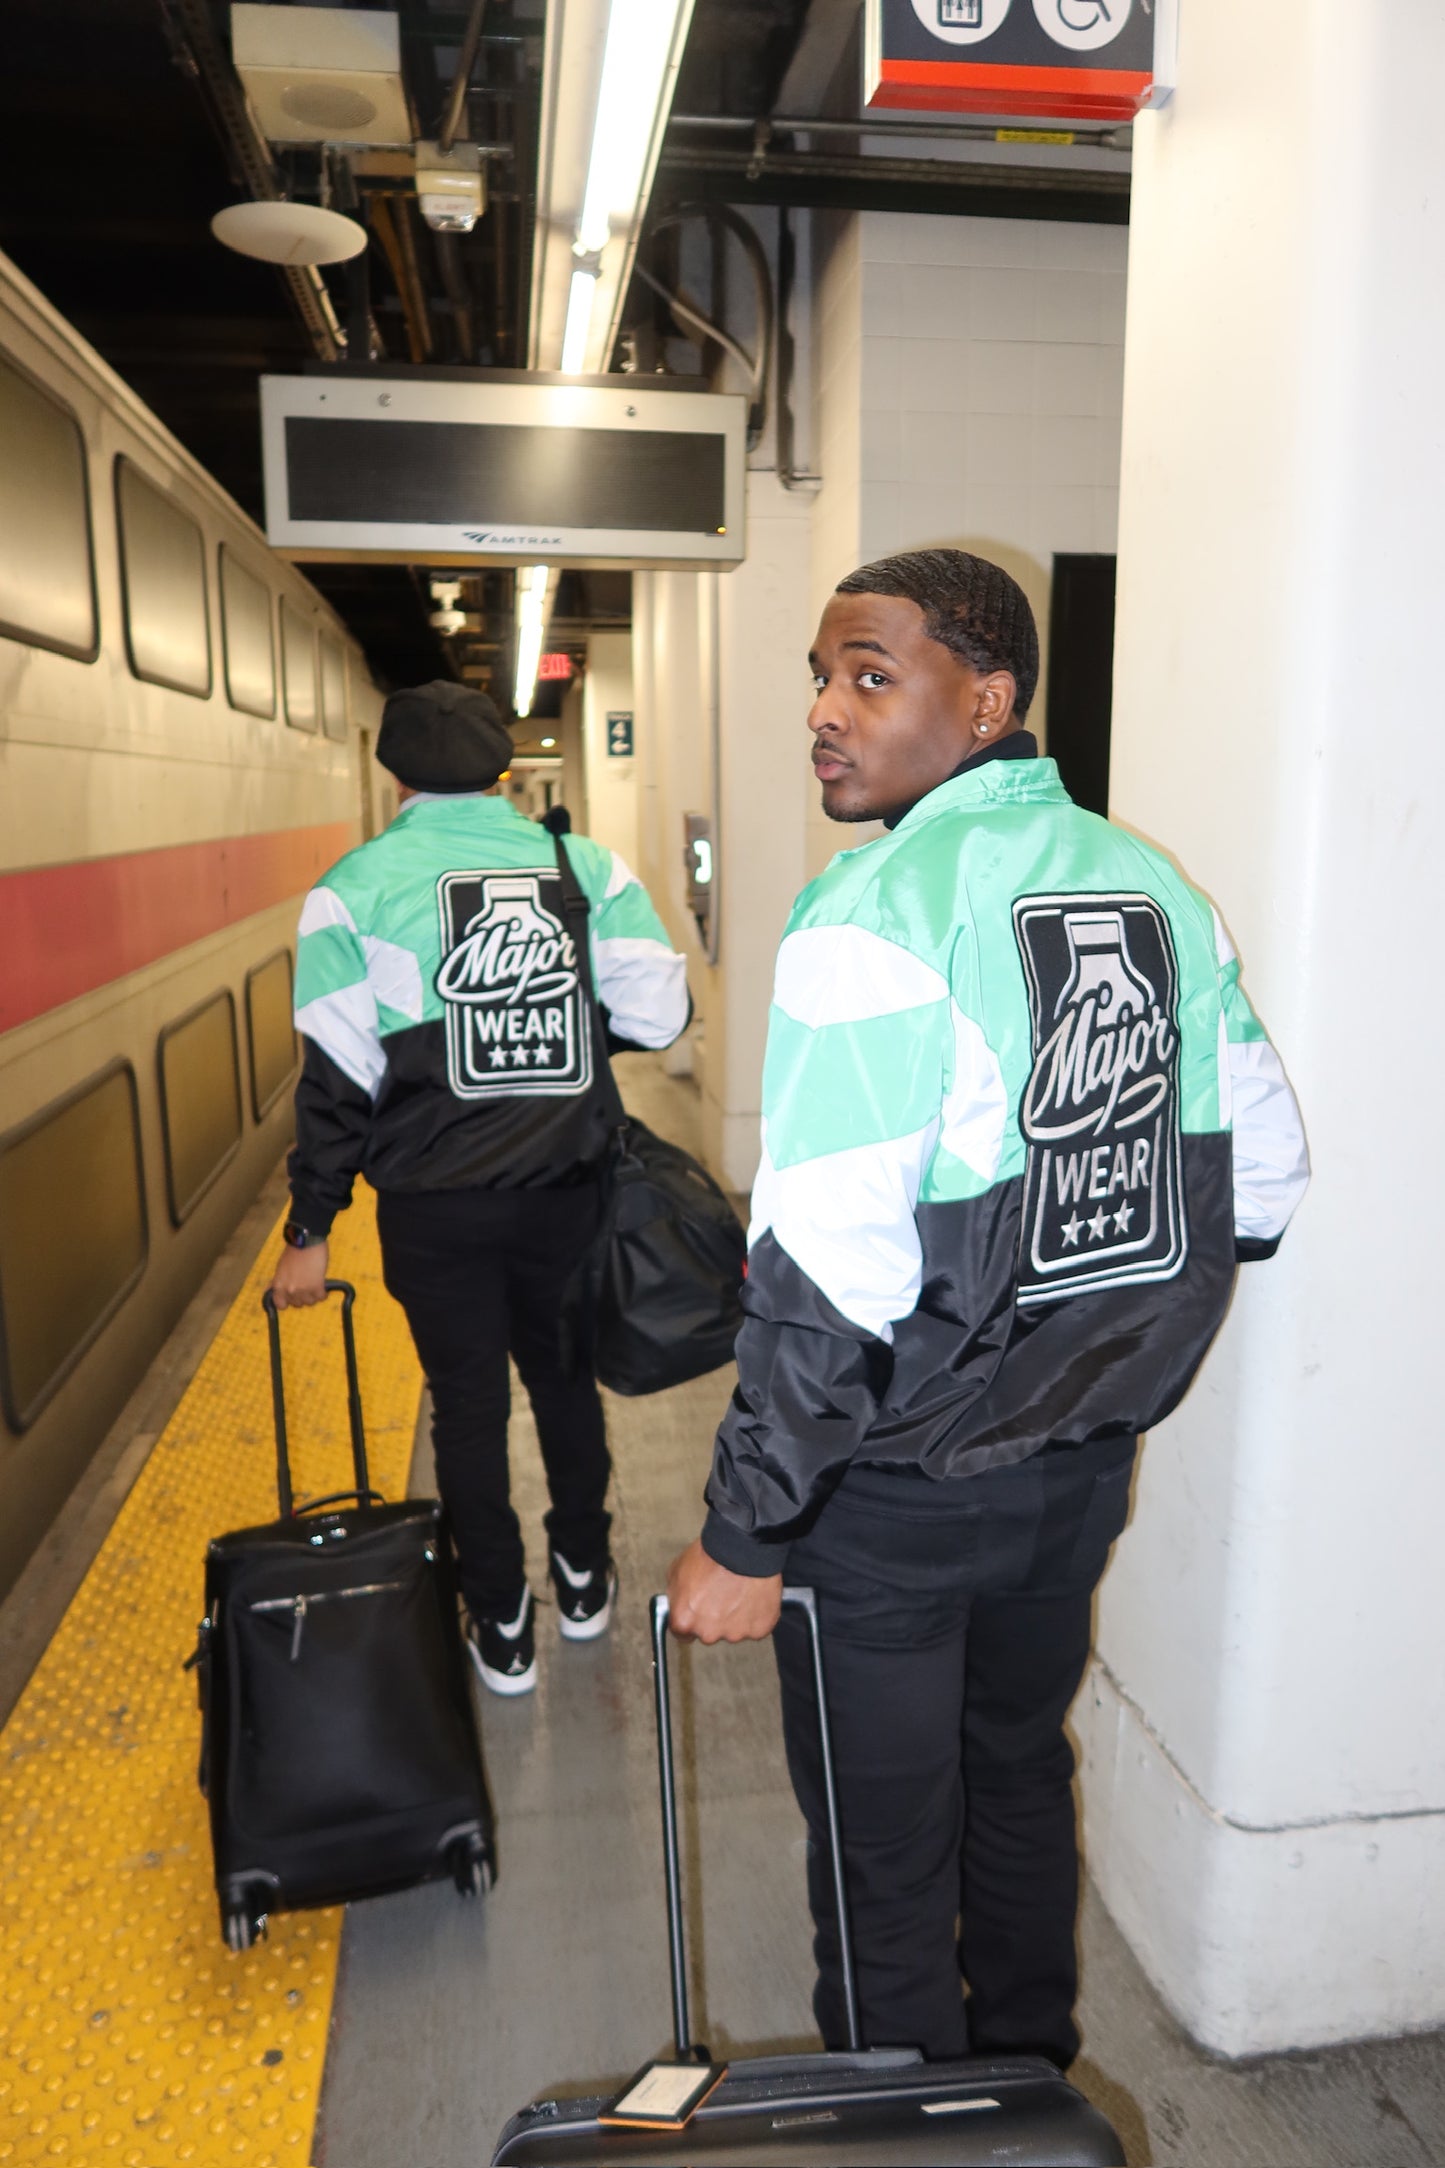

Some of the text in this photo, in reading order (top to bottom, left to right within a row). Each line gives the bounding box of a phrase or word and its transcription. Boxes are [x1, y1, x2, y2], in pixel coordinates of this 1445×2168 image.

[489, 535, 562, 544] AMTRAK
[611, 721, 626, 738] 4
[437, 924, 577, 1005] Major
[475, 1008, 564, 1043] WEAR
[1023, 999, 1174, 1140] Major
[1055, 1139, 1150, 1205] WEAR
